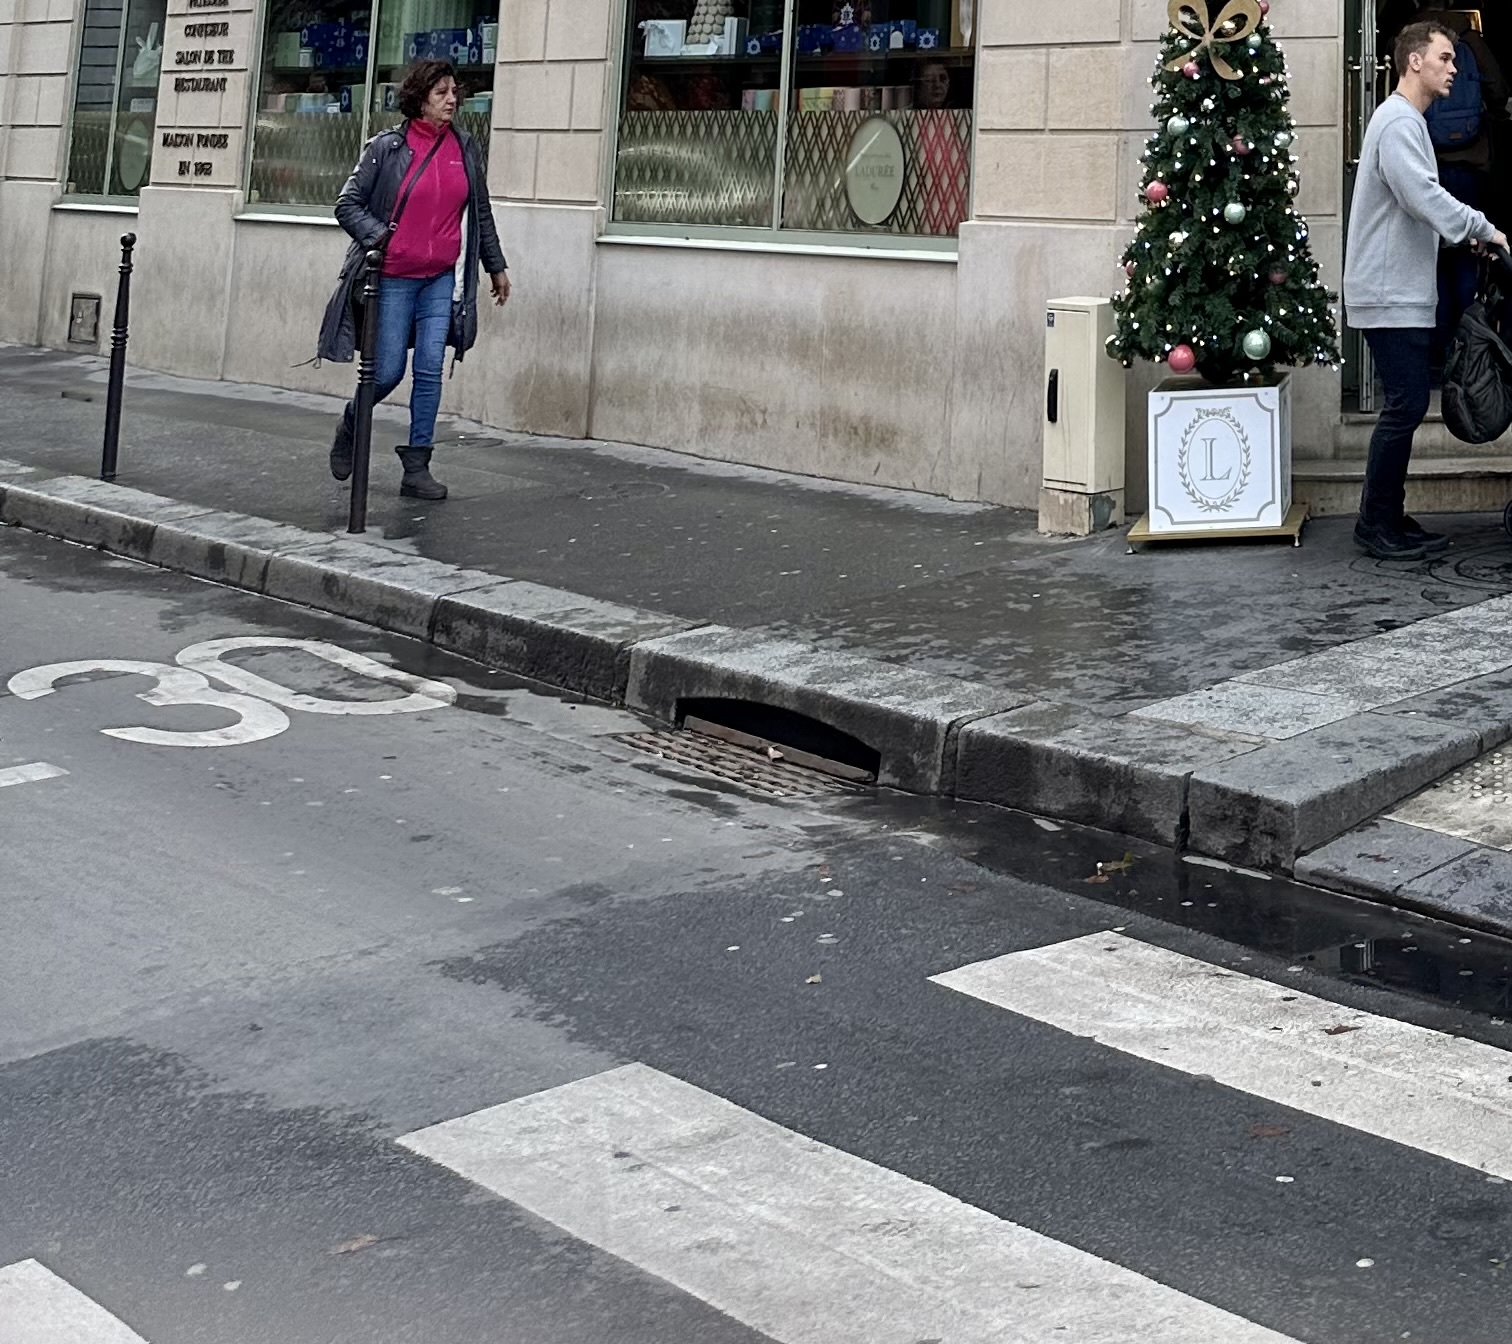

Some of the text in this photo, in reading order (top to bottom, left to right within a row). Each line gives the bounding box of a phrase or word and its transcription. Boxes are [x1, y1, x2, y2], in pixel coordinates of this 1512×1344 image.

[175, 51, 203, 66] SALON
[203, 50, 216, 65] DE
[174, 78, 227, 93] RESTAURANT
[1200, 437, 1232, 481] L
[8, 636, 457, 748] 30
